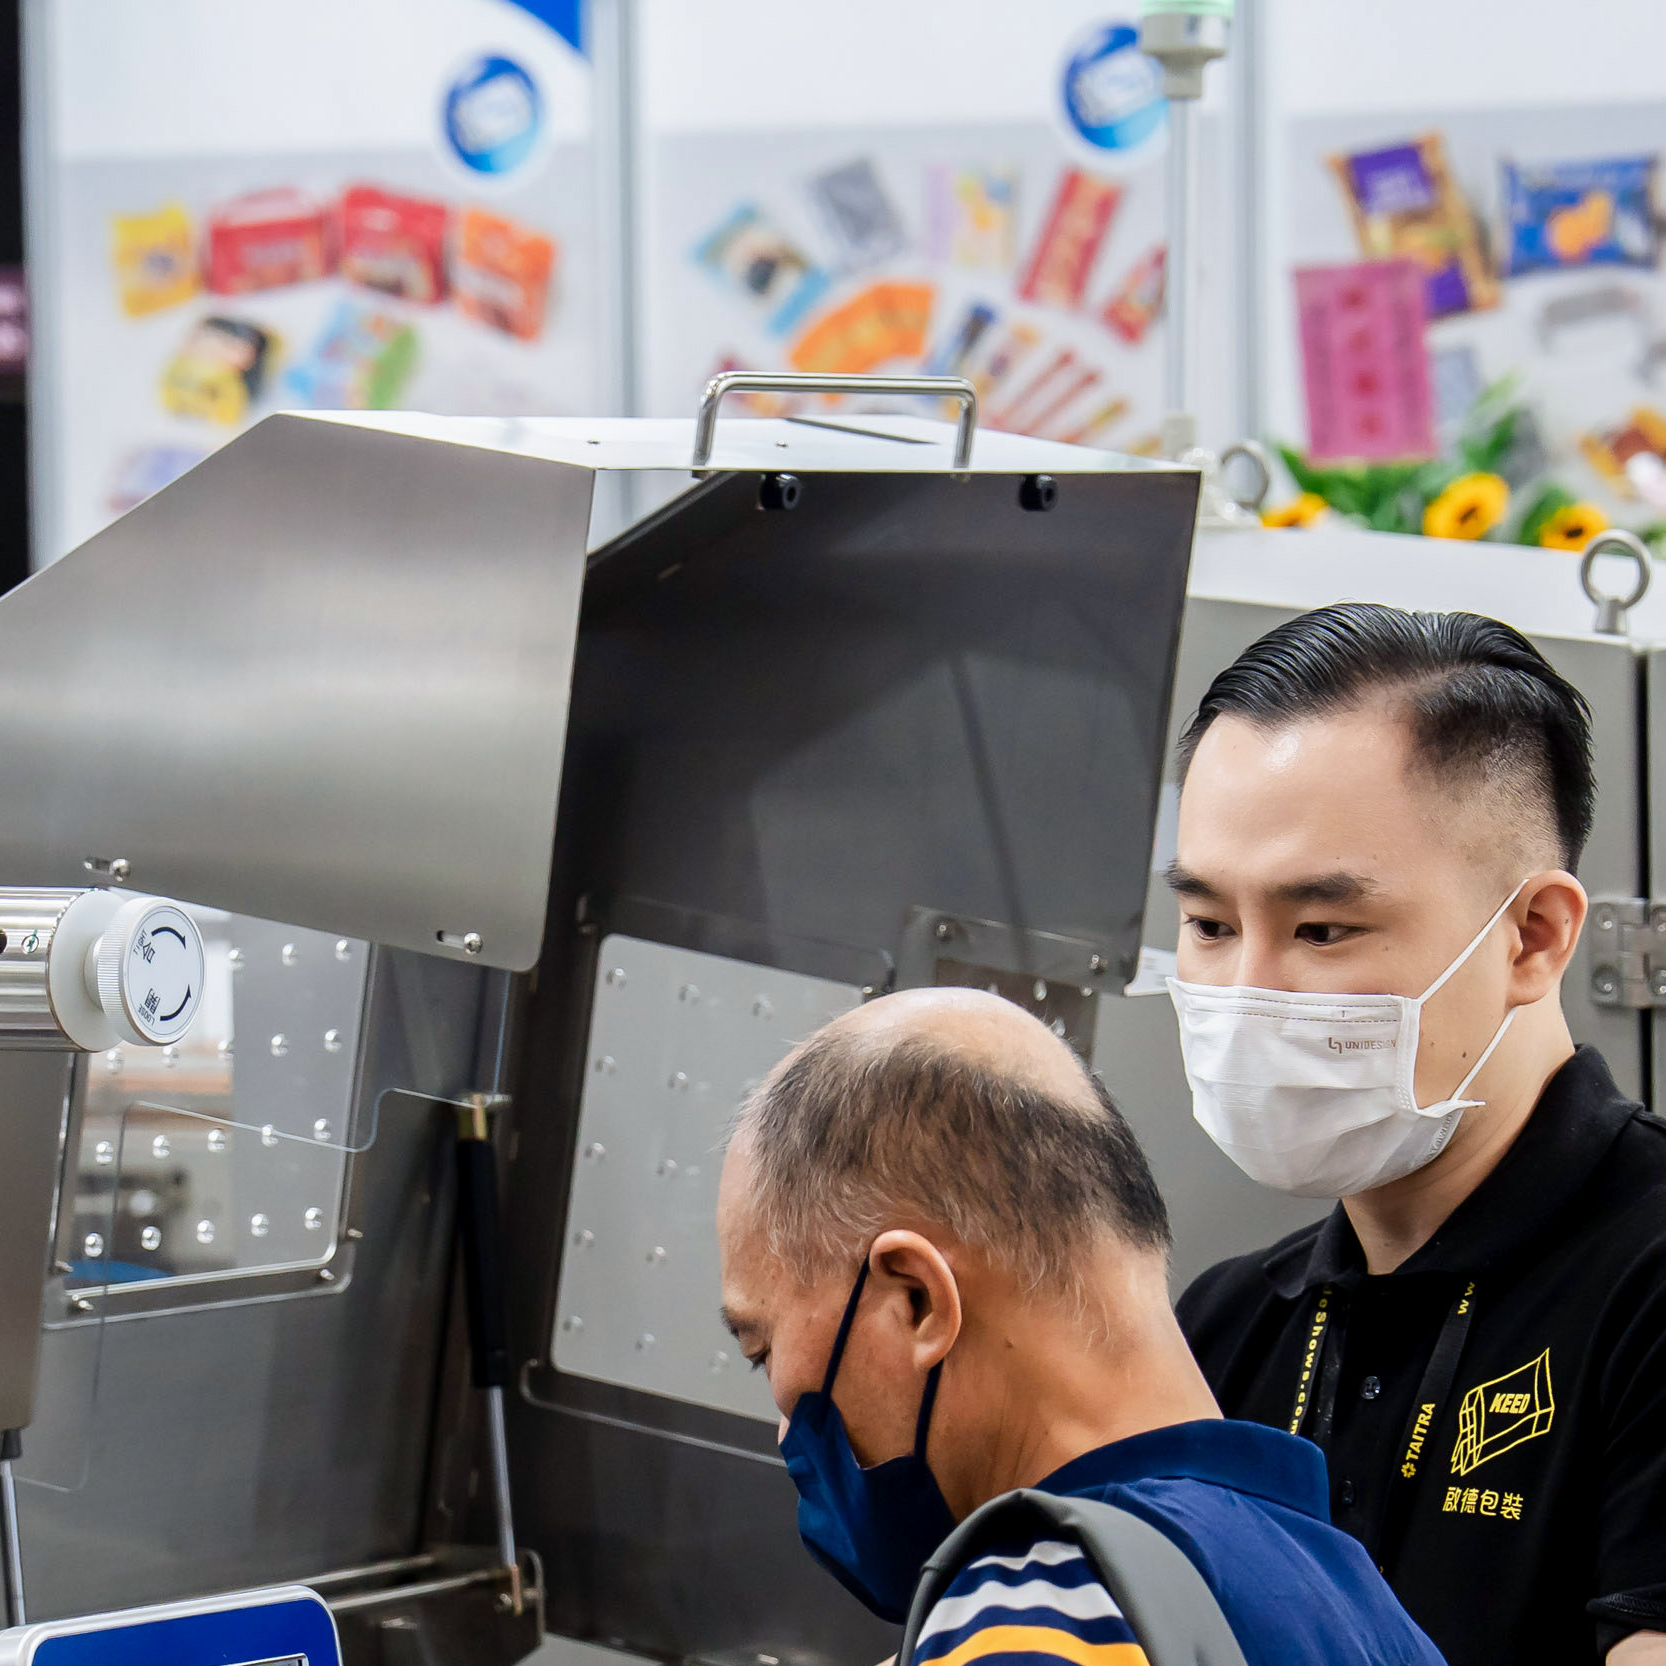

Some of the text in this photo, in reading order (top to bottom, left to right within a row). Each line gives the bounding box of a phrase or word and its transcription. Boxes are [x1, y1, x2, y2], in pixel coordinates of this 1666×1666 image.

[133, 929, 147, 955] TIGHT
[1489, 1393, 1531, 1414] KEED
[1405, 1402, 1436, 1461] TAITRA
